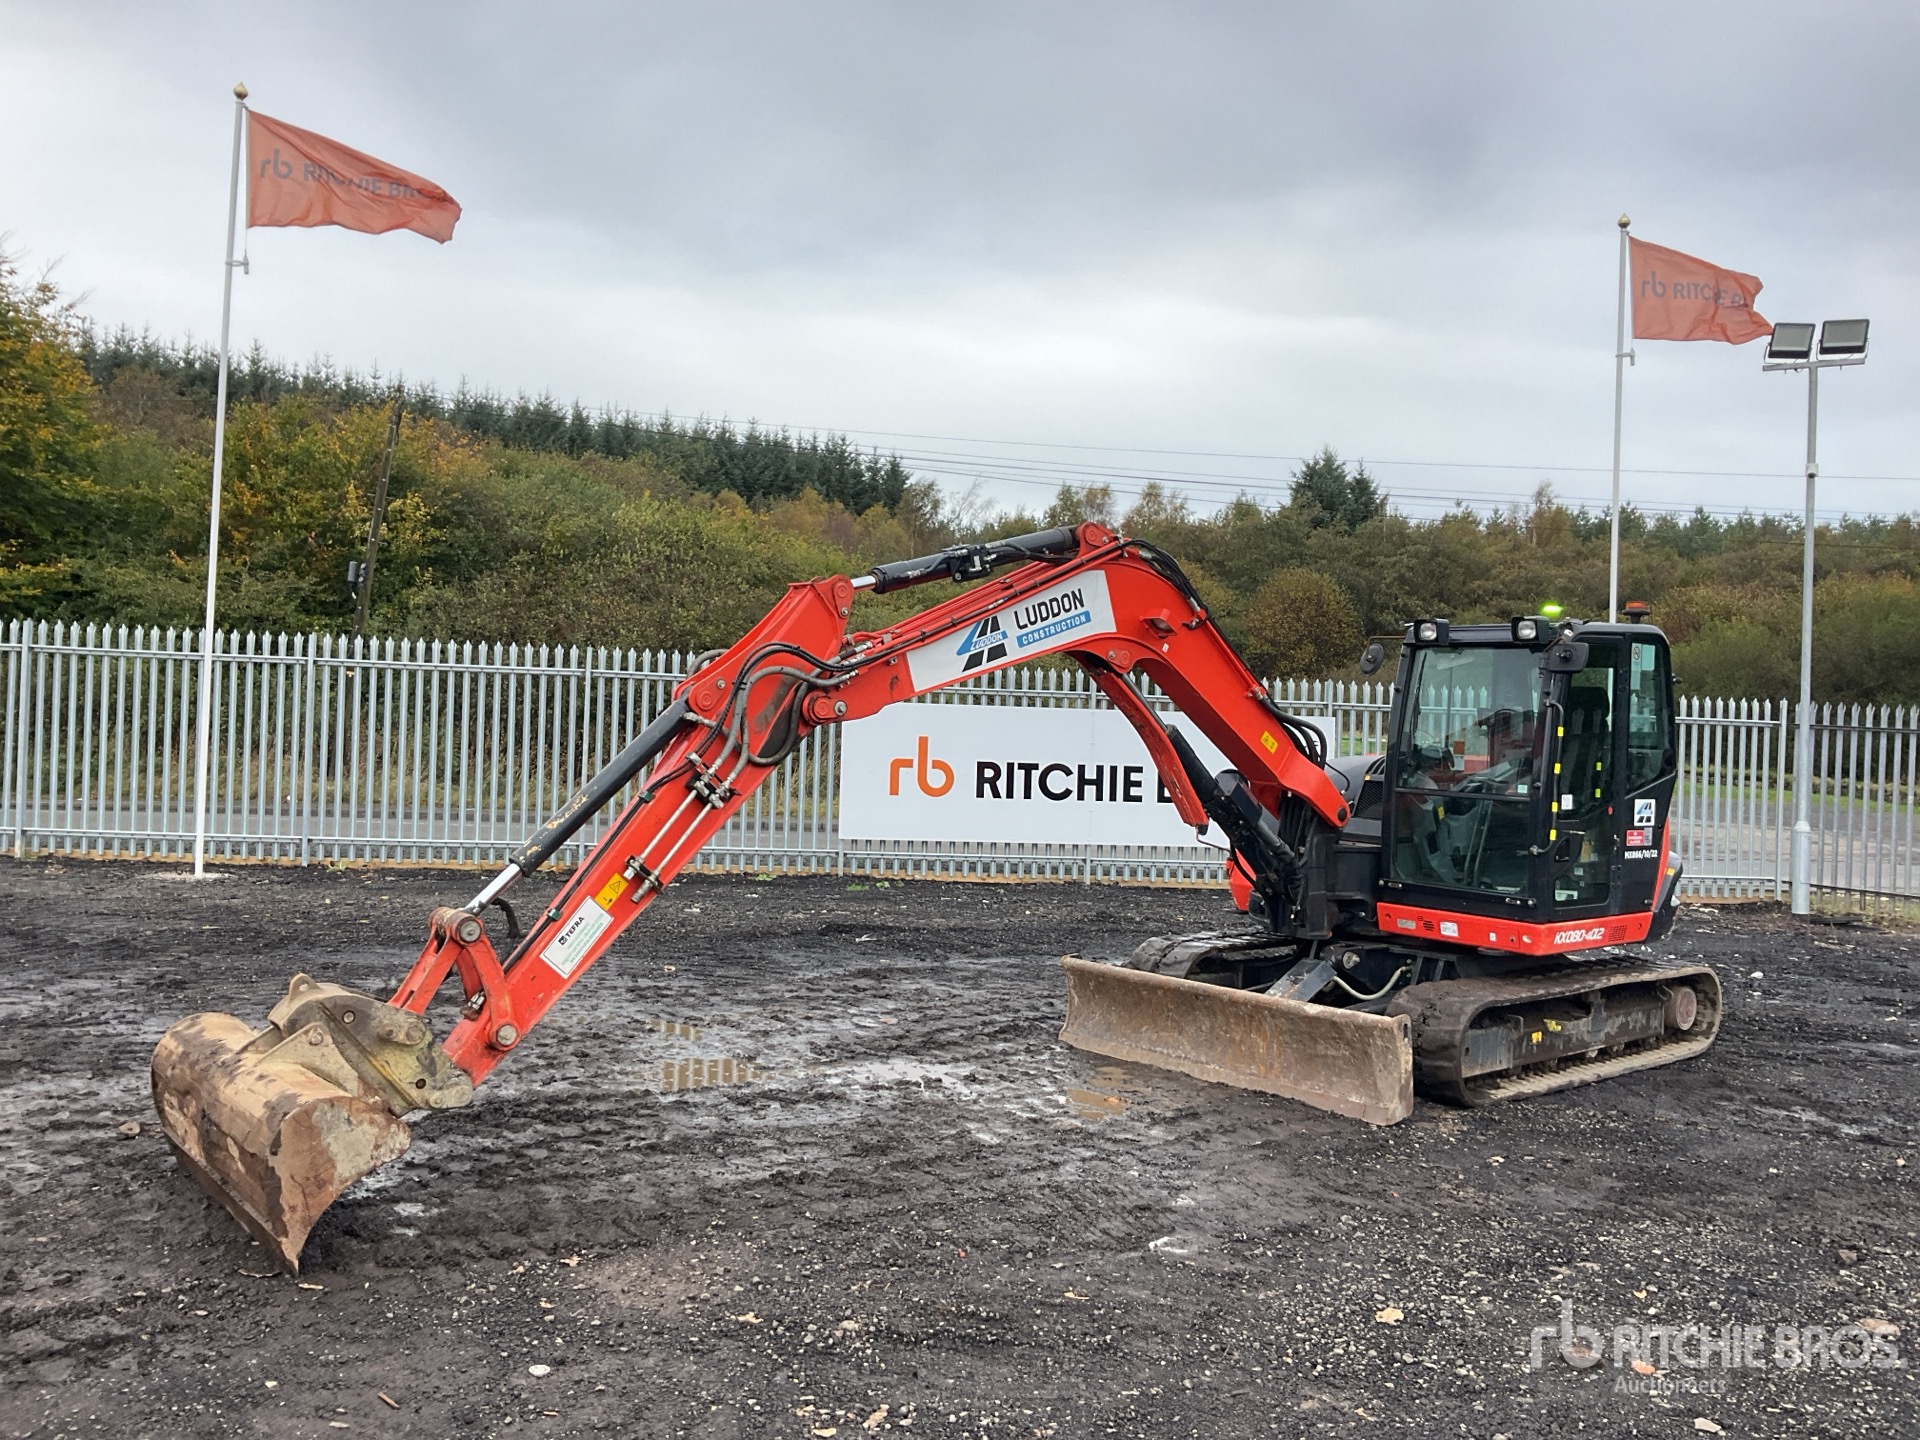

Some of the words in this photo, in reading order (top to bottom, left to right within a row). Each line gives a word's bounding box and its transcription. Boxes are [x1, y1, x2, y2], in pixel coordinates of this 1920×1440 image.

[1014, 588, 1086, 631] LUDDON
[970, 632, 1003, 651] LUDDON
[1022, 614, 1087, 645] CONSTRUCTION
[889, 735, 955, 798] rb
[975, 760, 1144, 804] RITCHIE
[565, 916, 585, 939] TEFRA
